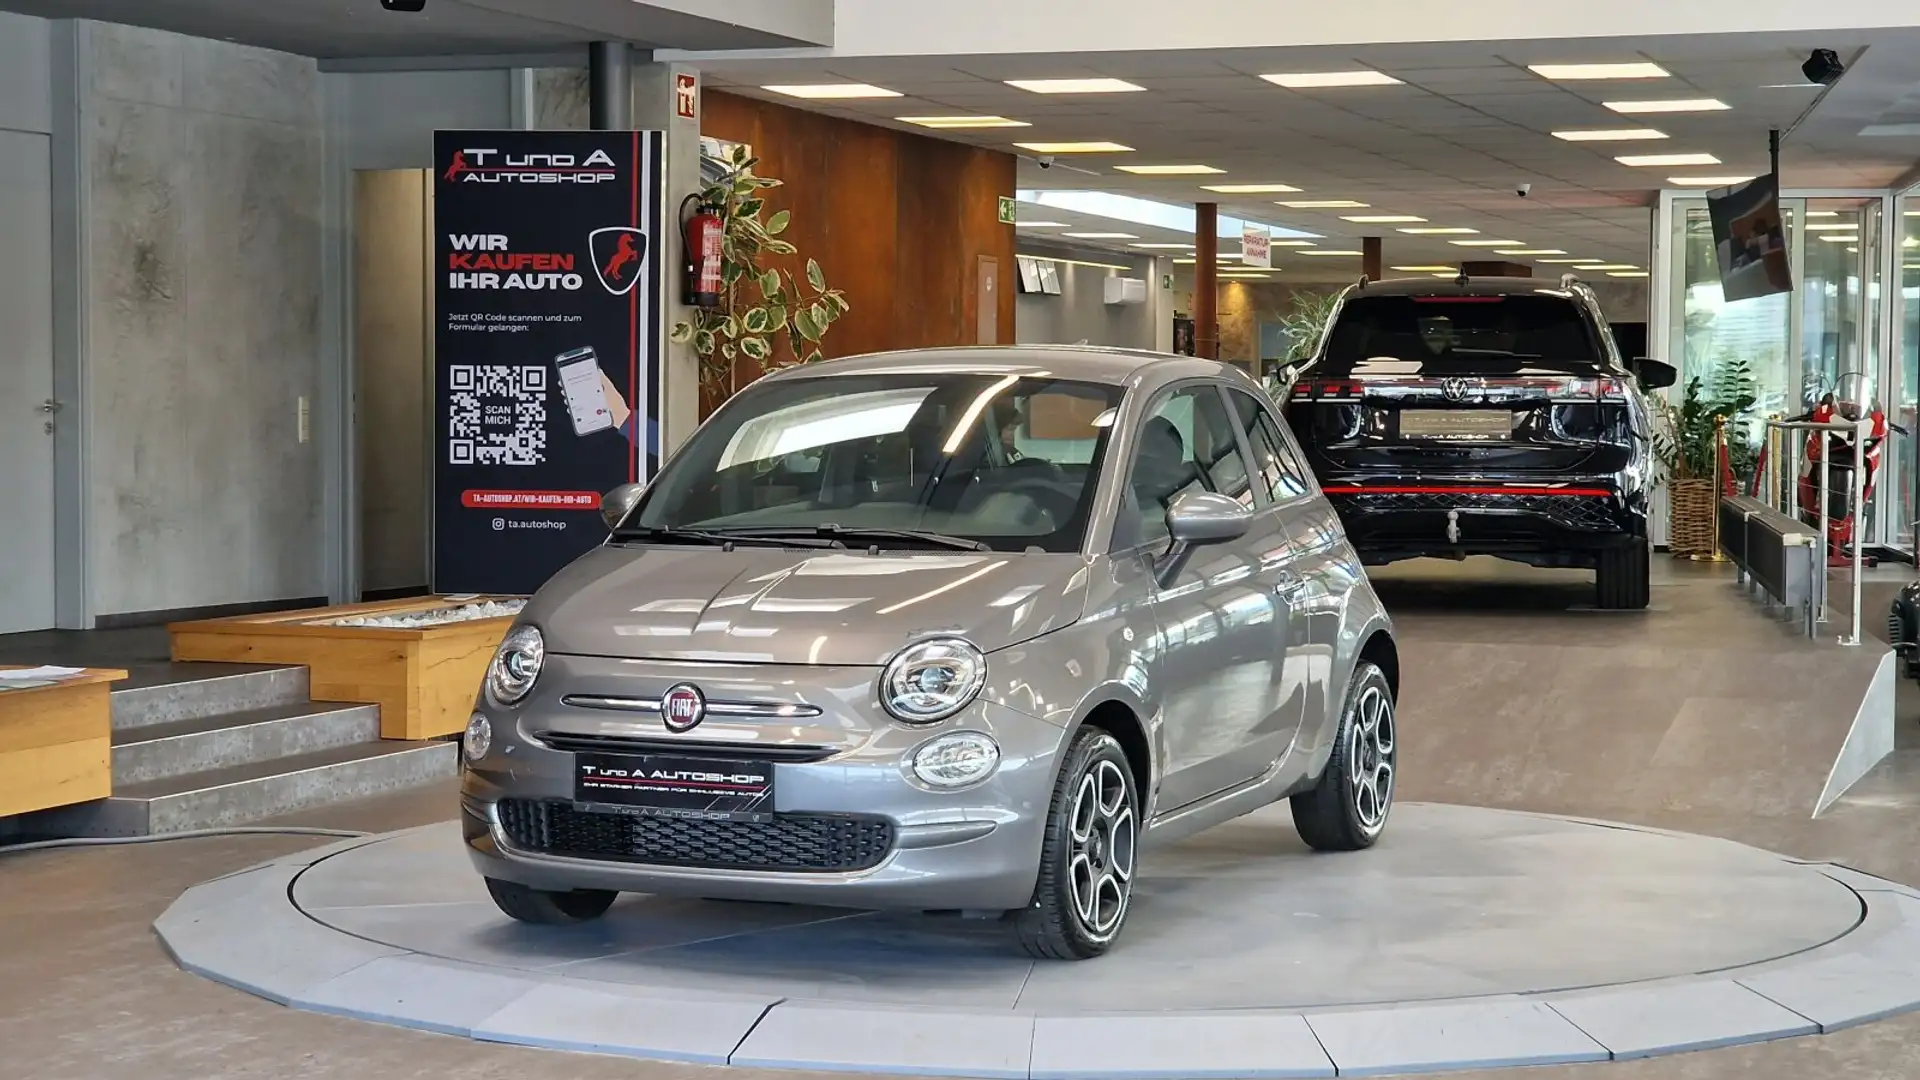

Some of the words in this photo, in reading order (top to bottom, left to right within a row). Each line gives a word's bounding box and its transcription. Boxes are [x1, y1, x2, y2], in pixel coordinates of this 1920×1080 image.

[463, 149, 498, 166] T
[582, 149, 616, 167] A
[463, 172, 616, 183] AUTOSHOP
[449, 234, 508, 250] WIR
[449, 253, 574, 270] KAUFEN
[449, 273, 500, 289] IHR
[502, 273, 583, 290] AUTO
[448, 313, 468, 321] Jetzt
[470, 314, 484, 322] QR
[485, 313, 506, 321] Code
[448, 323, 486, 331] Formular
[488, 324, 529, 332] gelangen:
[484, 405, 511, 414] SCAN
[484, 415, 511, 425] MICH
[508, 520, 567, 531] ta.autoshop
[671, 698, 694, 717] FIAT
[582, 765, 597, 775] T
[632, 769, 646, 778] A
[651, 769, 764, 783] AUTOSHOP
[654, 808, 730, 820] AUTOSHOP
